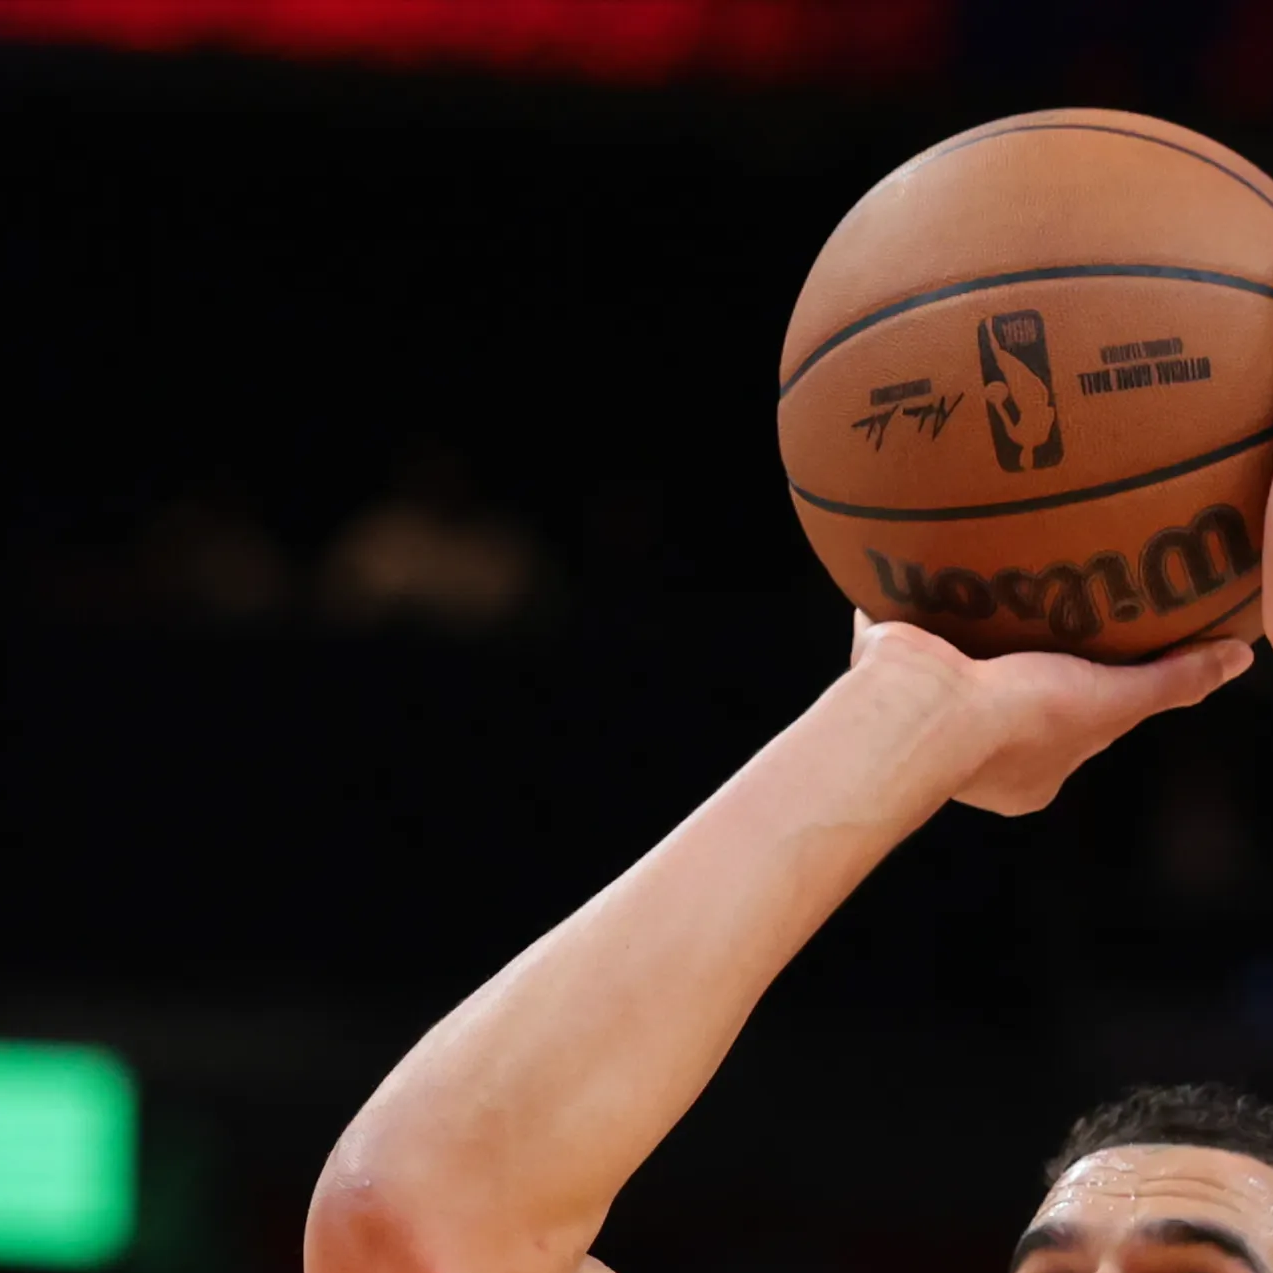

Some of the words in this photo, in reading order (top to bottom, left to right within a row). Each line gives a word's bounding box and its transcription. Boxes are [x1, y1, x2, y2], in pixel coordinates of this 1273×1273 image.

[1001, 318, 1037, 348] NBA
[1076, 369, 1114, 396] BALL
[1113, 363, 1153, 391] GAME
[865, 503, 1261, 642] Wilson
